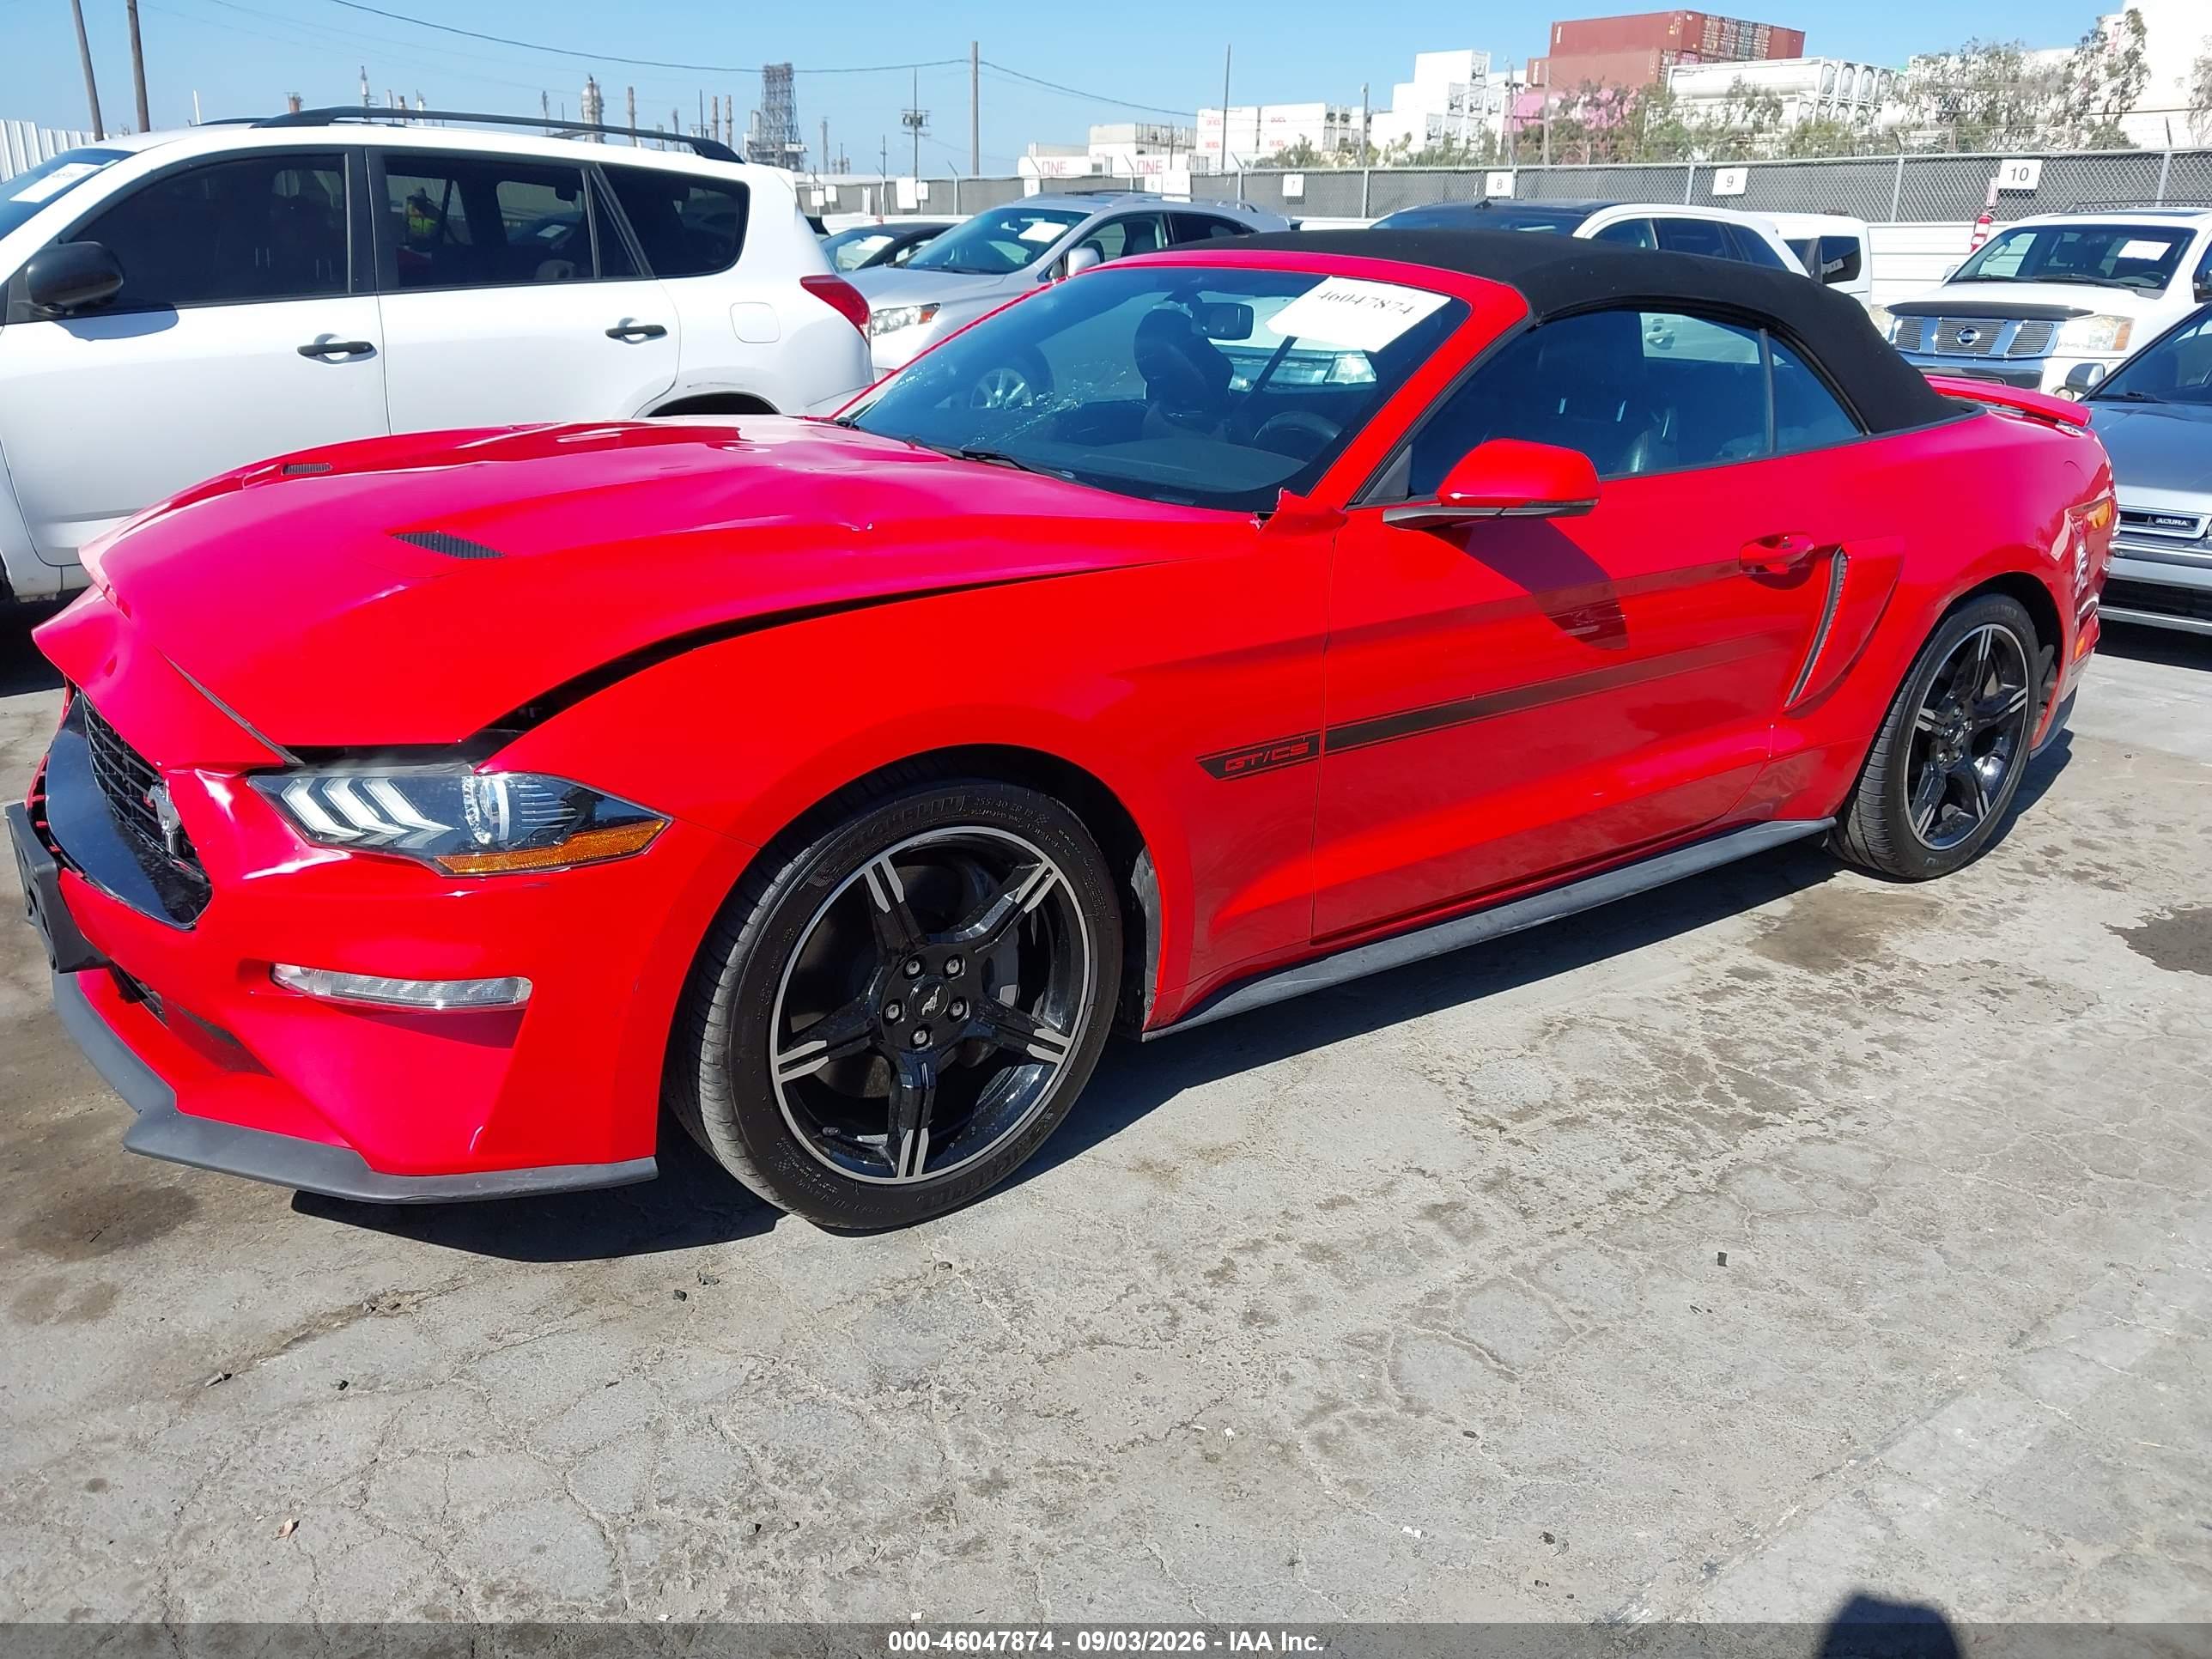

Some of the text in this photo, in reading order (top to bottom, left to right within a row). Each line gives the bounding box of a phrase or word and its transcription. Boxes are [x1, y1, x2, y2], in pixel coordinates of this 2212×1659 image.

[1042, 161, 1066, 175] ONE
[1136, 160, 1163, 174] ONE
[2010, 167, 2029, 181] 10
[1496, 179, 1503, 190] 8
[1726, 175, 1735, 188] 9
[1317, 290, 1415, 314] 46047874
[2155, 517, 2188, 526] ACURA
